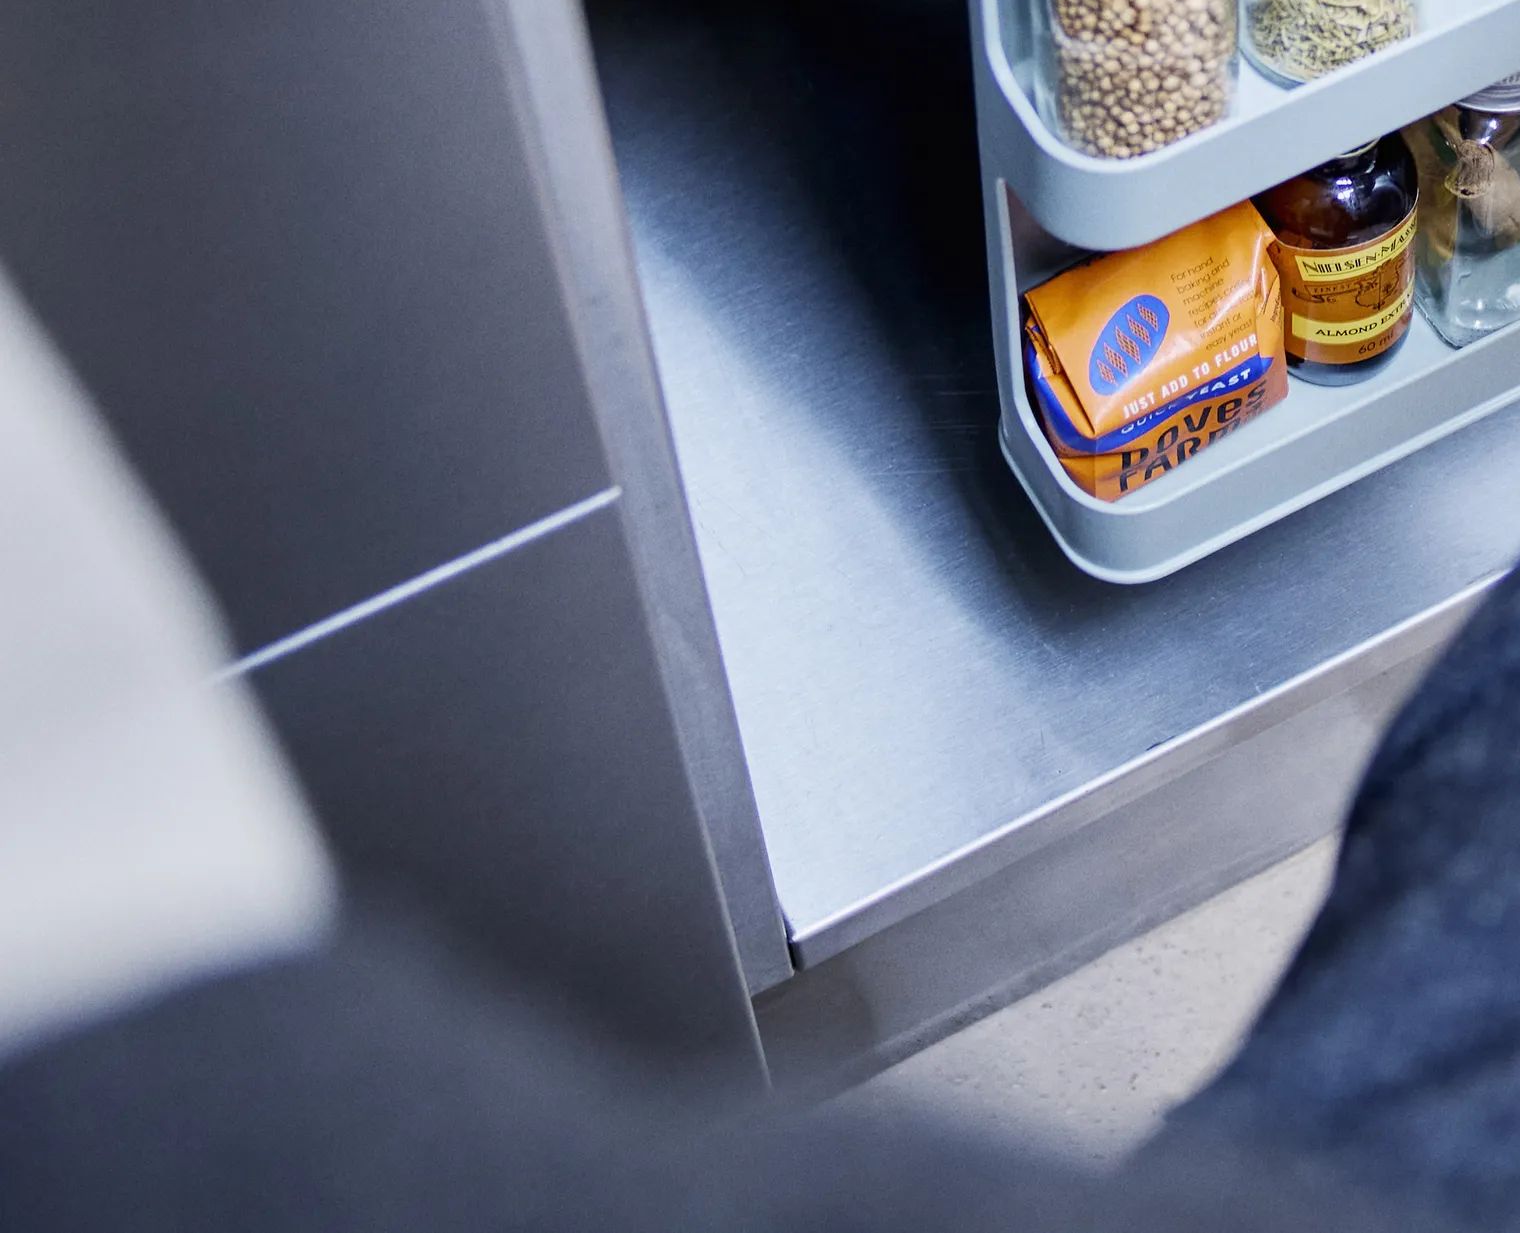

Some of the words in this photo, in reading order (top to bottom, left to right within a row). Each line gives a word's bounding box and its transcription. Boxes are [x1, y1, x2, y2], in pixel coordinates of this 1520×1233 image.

[1176, 273, 1211, 295] baking
[1211, 257, 1231, 276] and
[1187, 256, 1214, 277] hand
[1315, 321, 1378, 338] ALMOND
[1380, 292, 1412, 326] EXTR
[1357, 341, 1376, 356] 60
[1122, 391, 1155, 420] JUST
[1160, 375, 1189, 399] ADD
[1191, 362, 1211, 380] TO
[1214, 333, 1258, 369] FLOUR
[1185, 368, 1251, 401] YEAST
